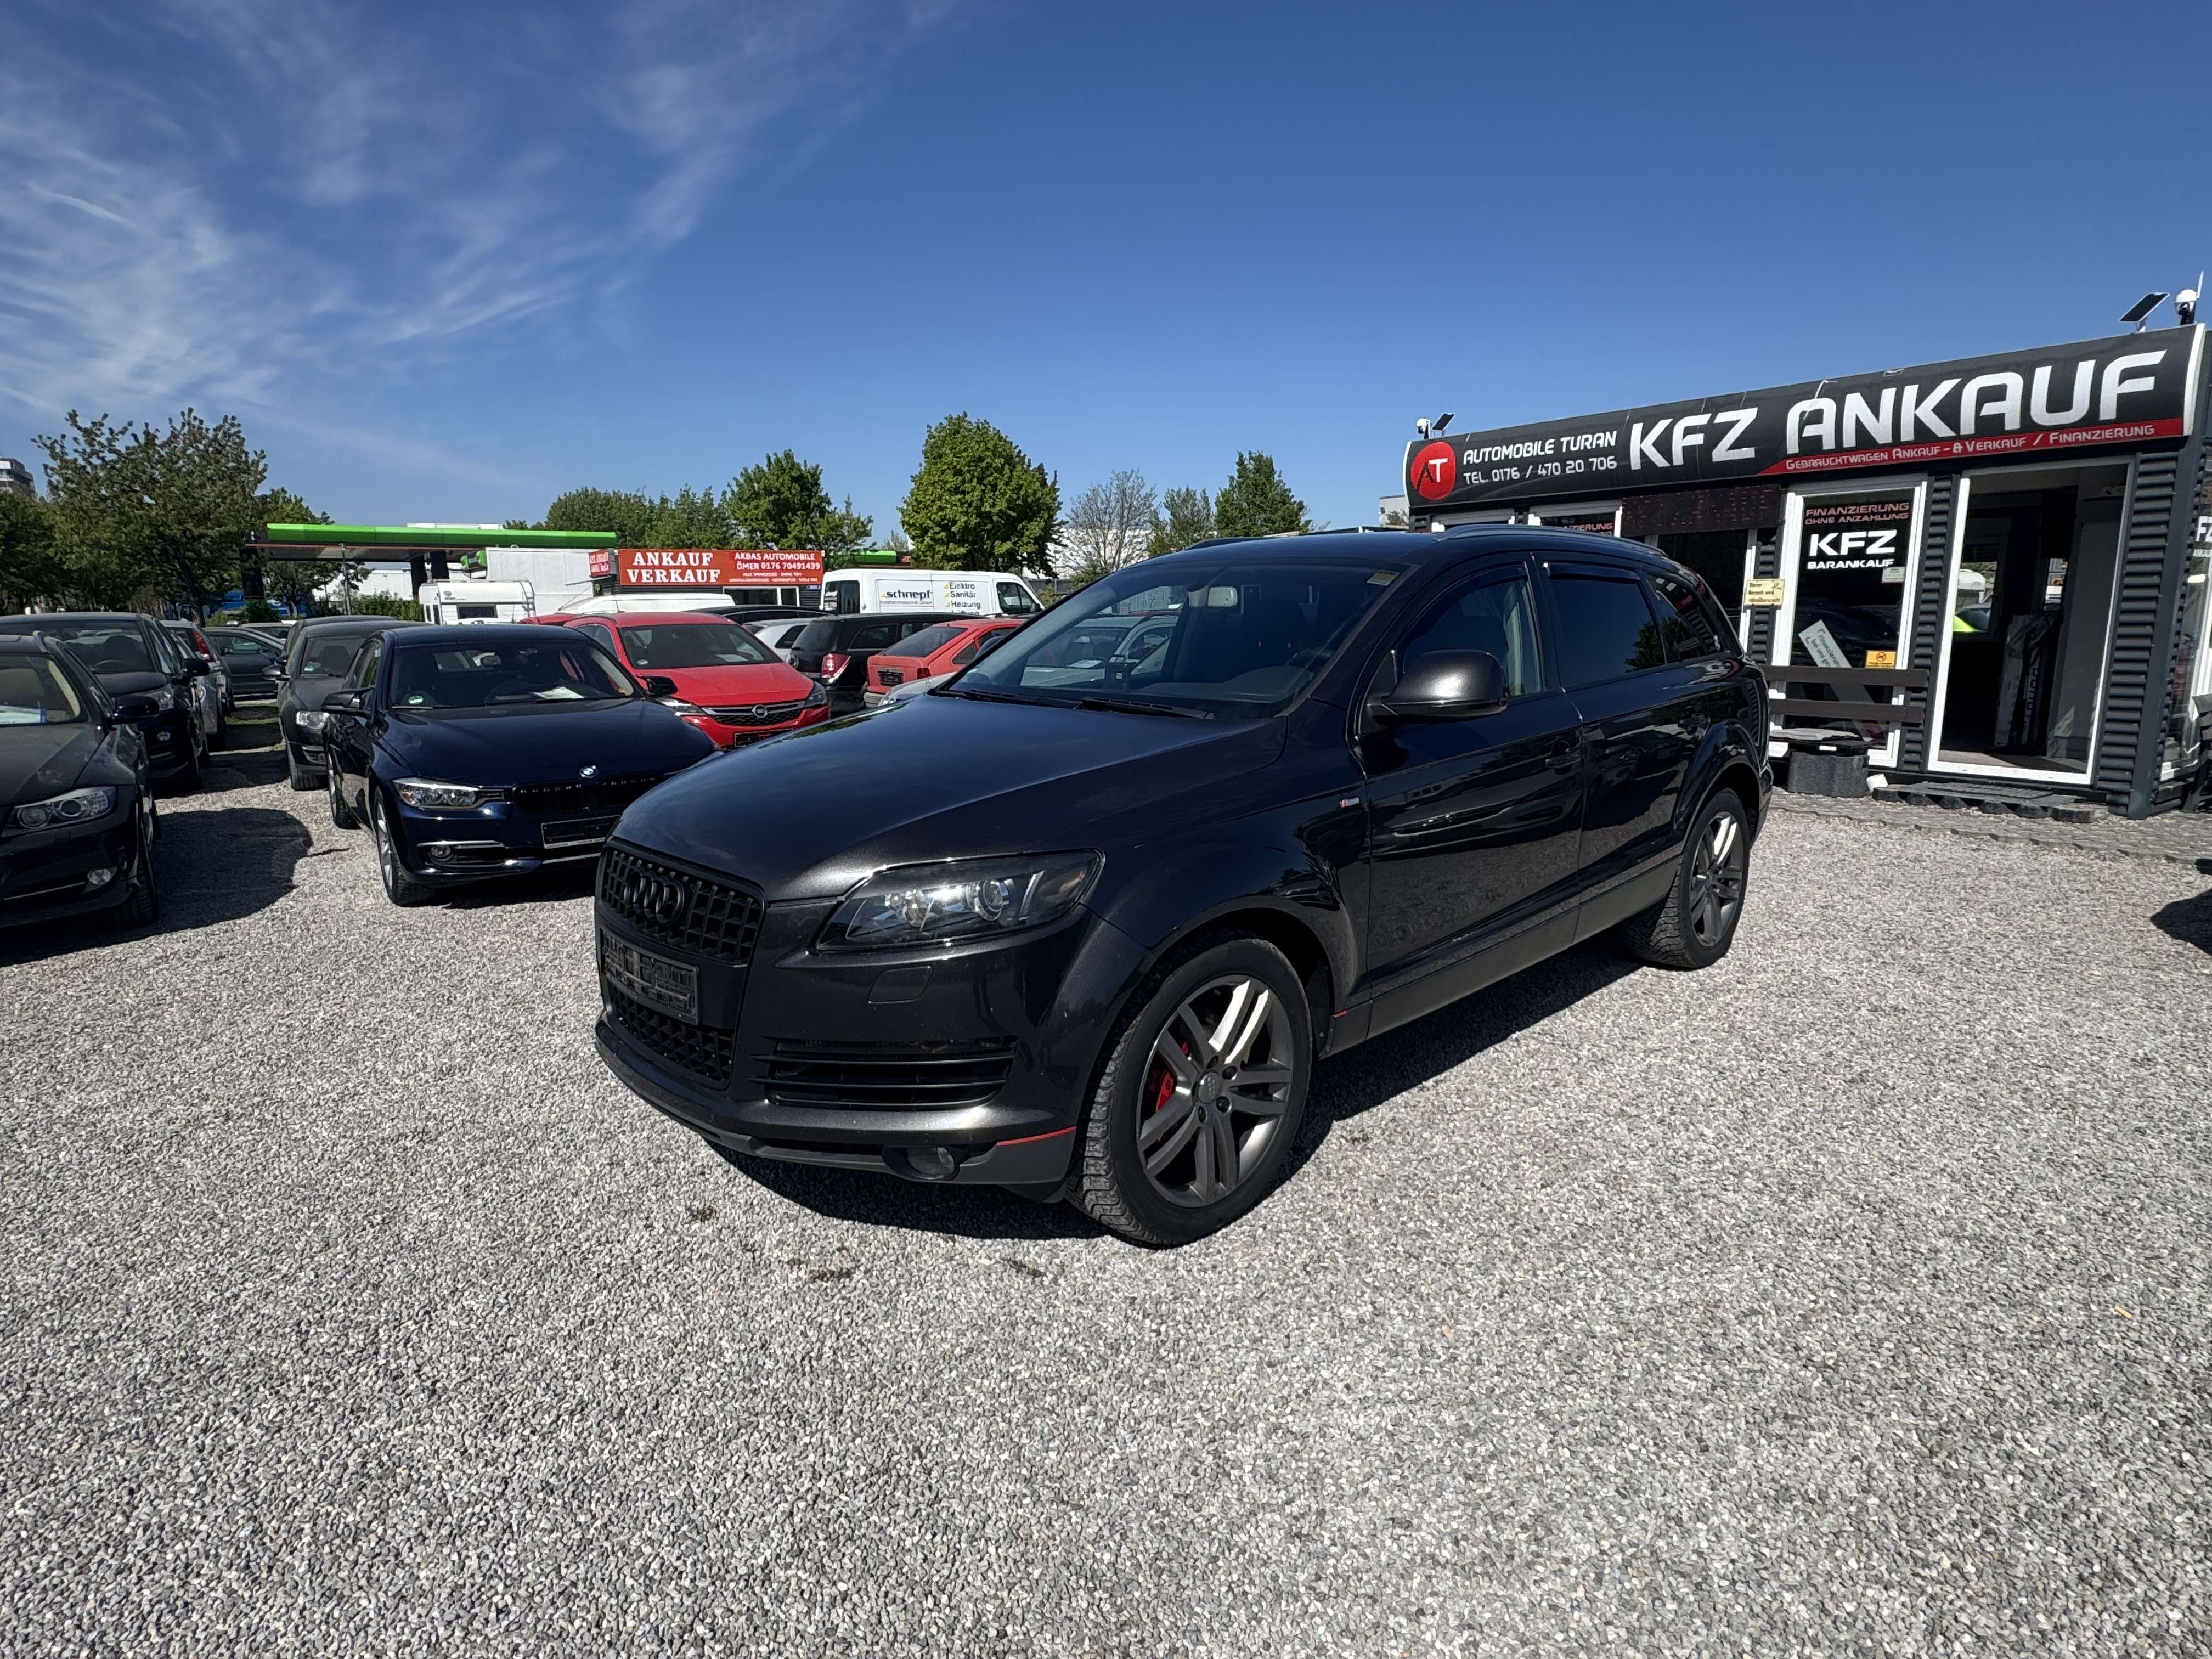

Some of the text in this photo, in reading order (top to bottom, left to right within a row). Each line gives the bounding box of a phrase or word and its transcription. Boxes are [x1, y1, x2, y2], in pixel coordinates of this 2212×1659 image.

[1630, 349, 2167, 470] KFZ ANKAUF
[1463, 431, 1617, 465] AUTOMOBILE TURAN
[1463, 471, 1489, 485] TEL.
[1492, 467, 1520, 482] 0176
[1538, 462, 1561, 476] 470
[1566, 460, 1584, 473] 20
[1589, 455, 1617, 471] 706
[1805, 503, 1910, 517] FINANZIERUNG
[1838, 513, 1909, 523] ANZAHLUNG
[1809, 529, 1897, 556] KFZ
[633, 552, 713, 566] ANKAUF
[1807, 558, 1895, 570] BARANKAUF
[627, 569, 721, 583] VERKAUF
[887, 590, 933, 601] schnepf
[951, 601, 981, 610] Heizung
